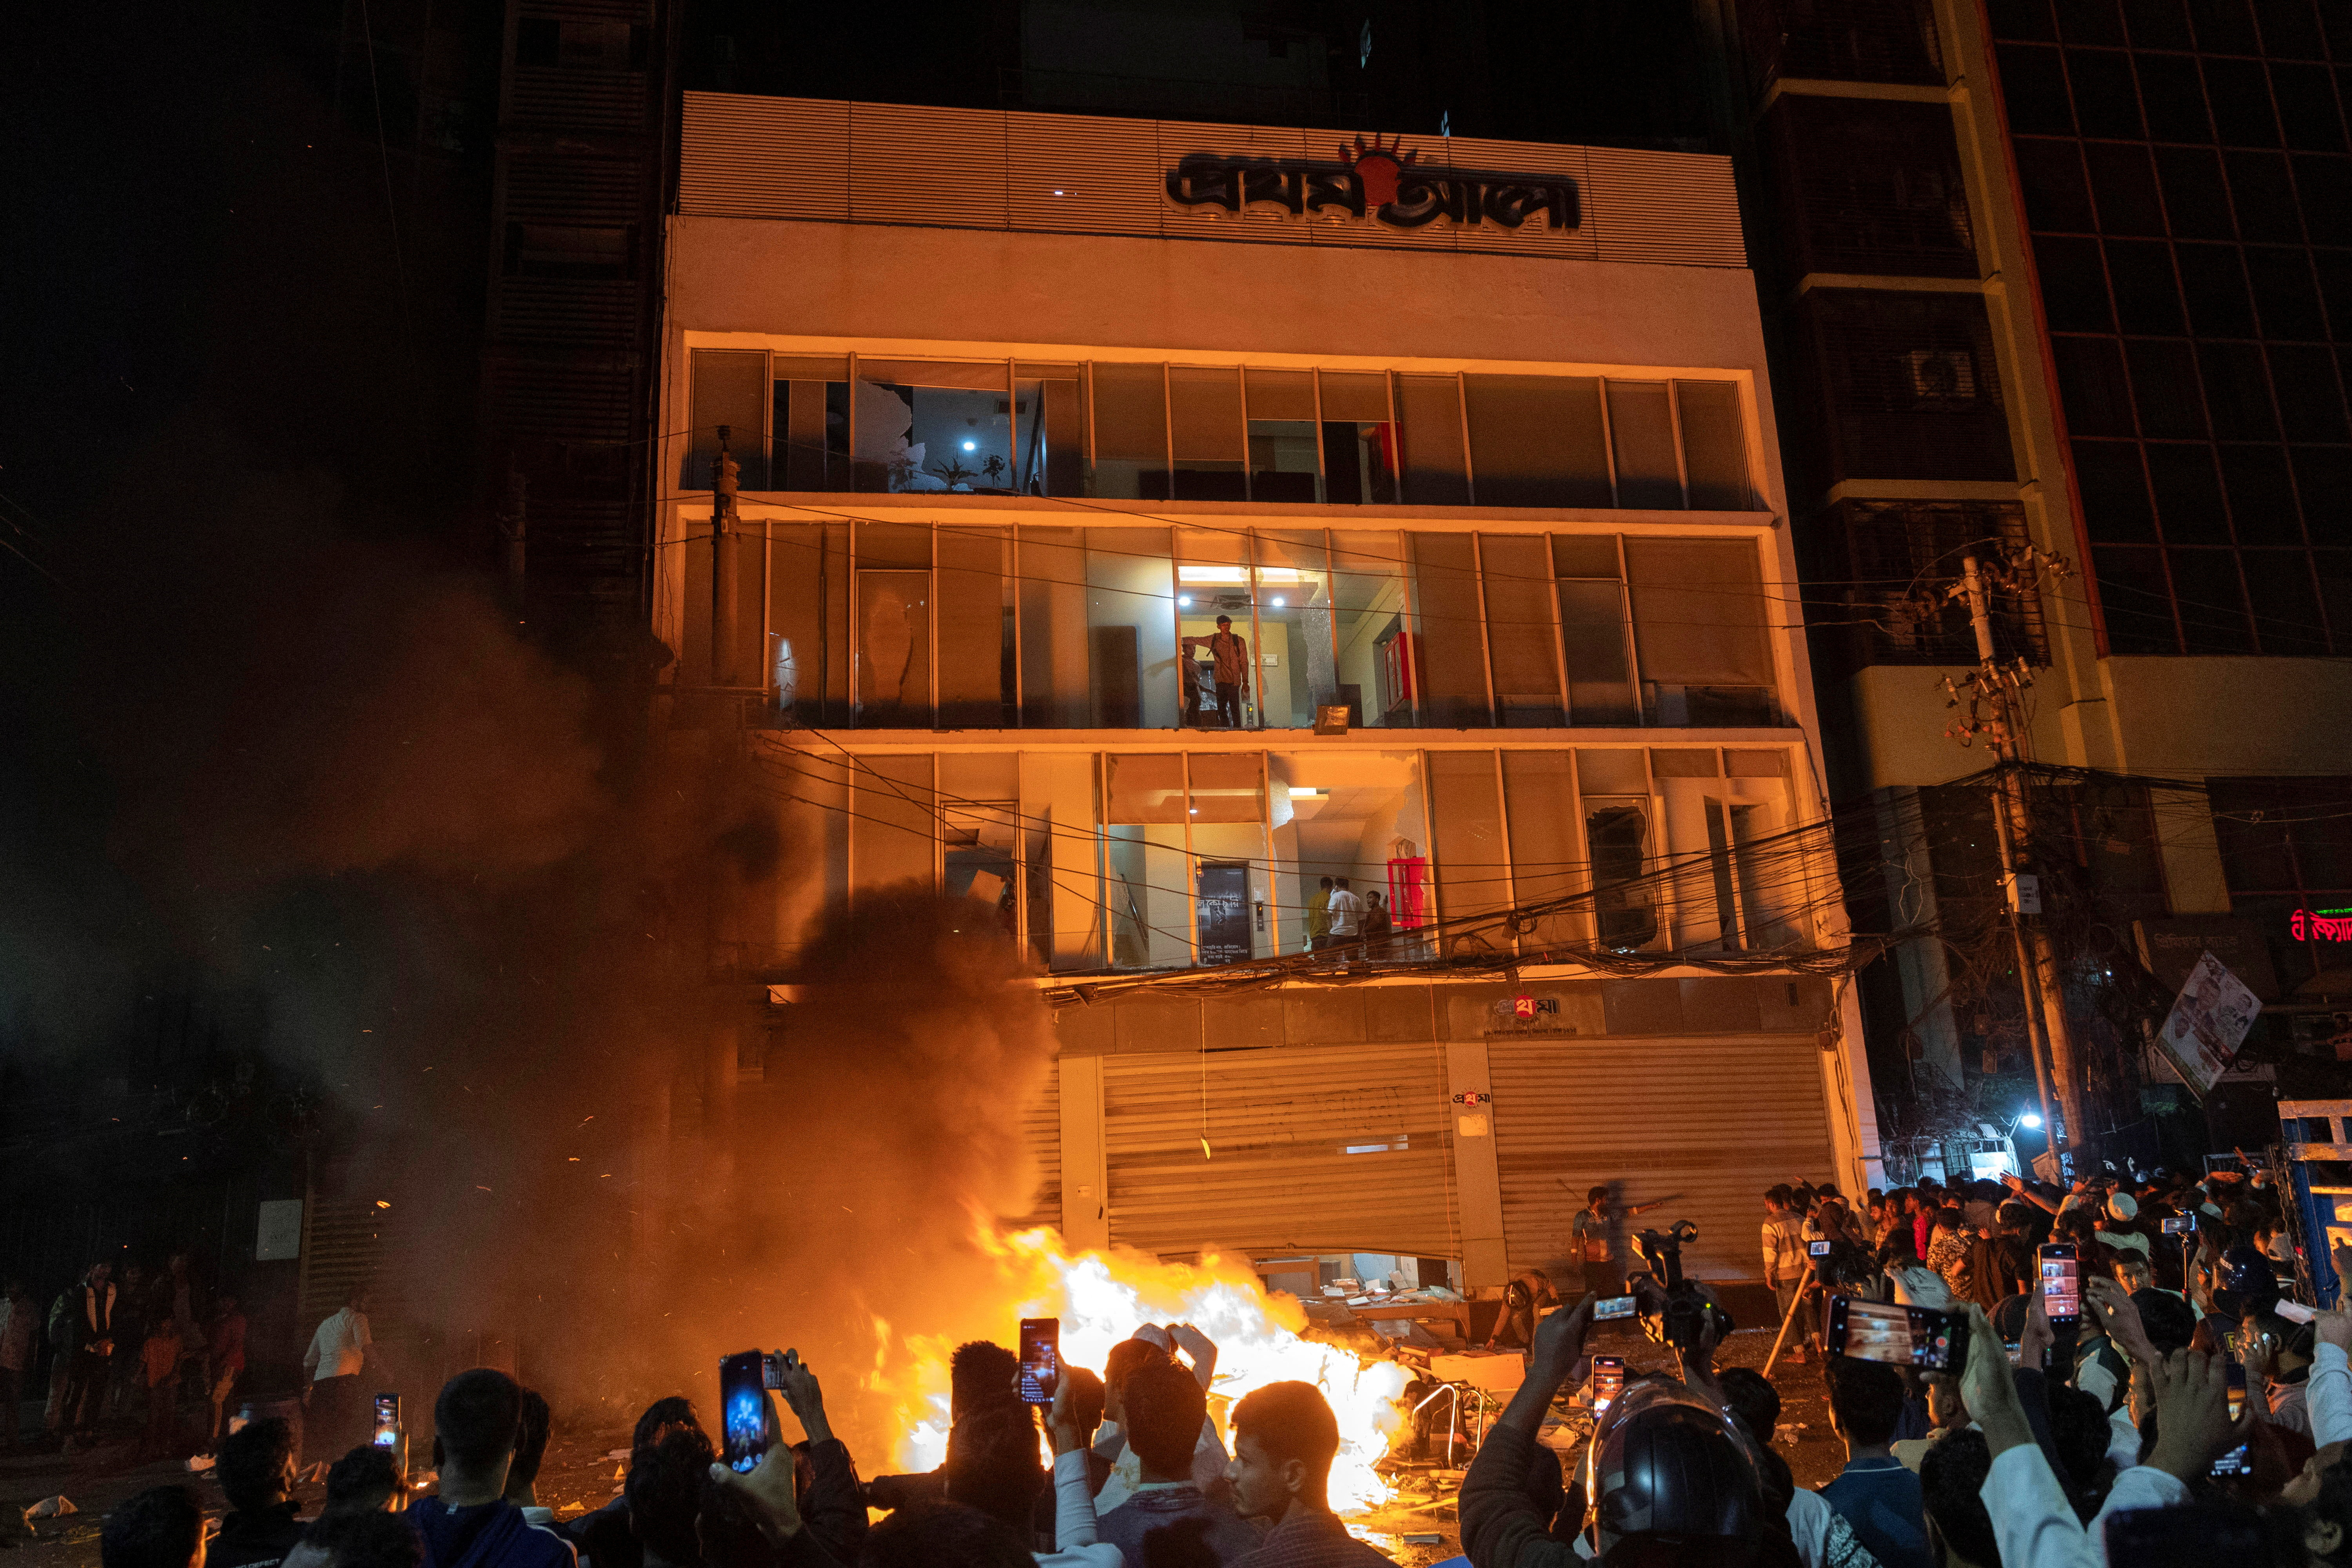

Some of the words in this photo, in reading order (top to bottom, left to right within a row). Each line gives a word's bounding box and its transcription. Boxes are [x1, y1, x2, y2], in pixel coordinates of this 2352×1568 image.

[1166, 154, 1366, 219] প্রথম
[1377, 165, 1581, 229] আলো
[1452, 1093, 1491, 1104] প্রথমা
